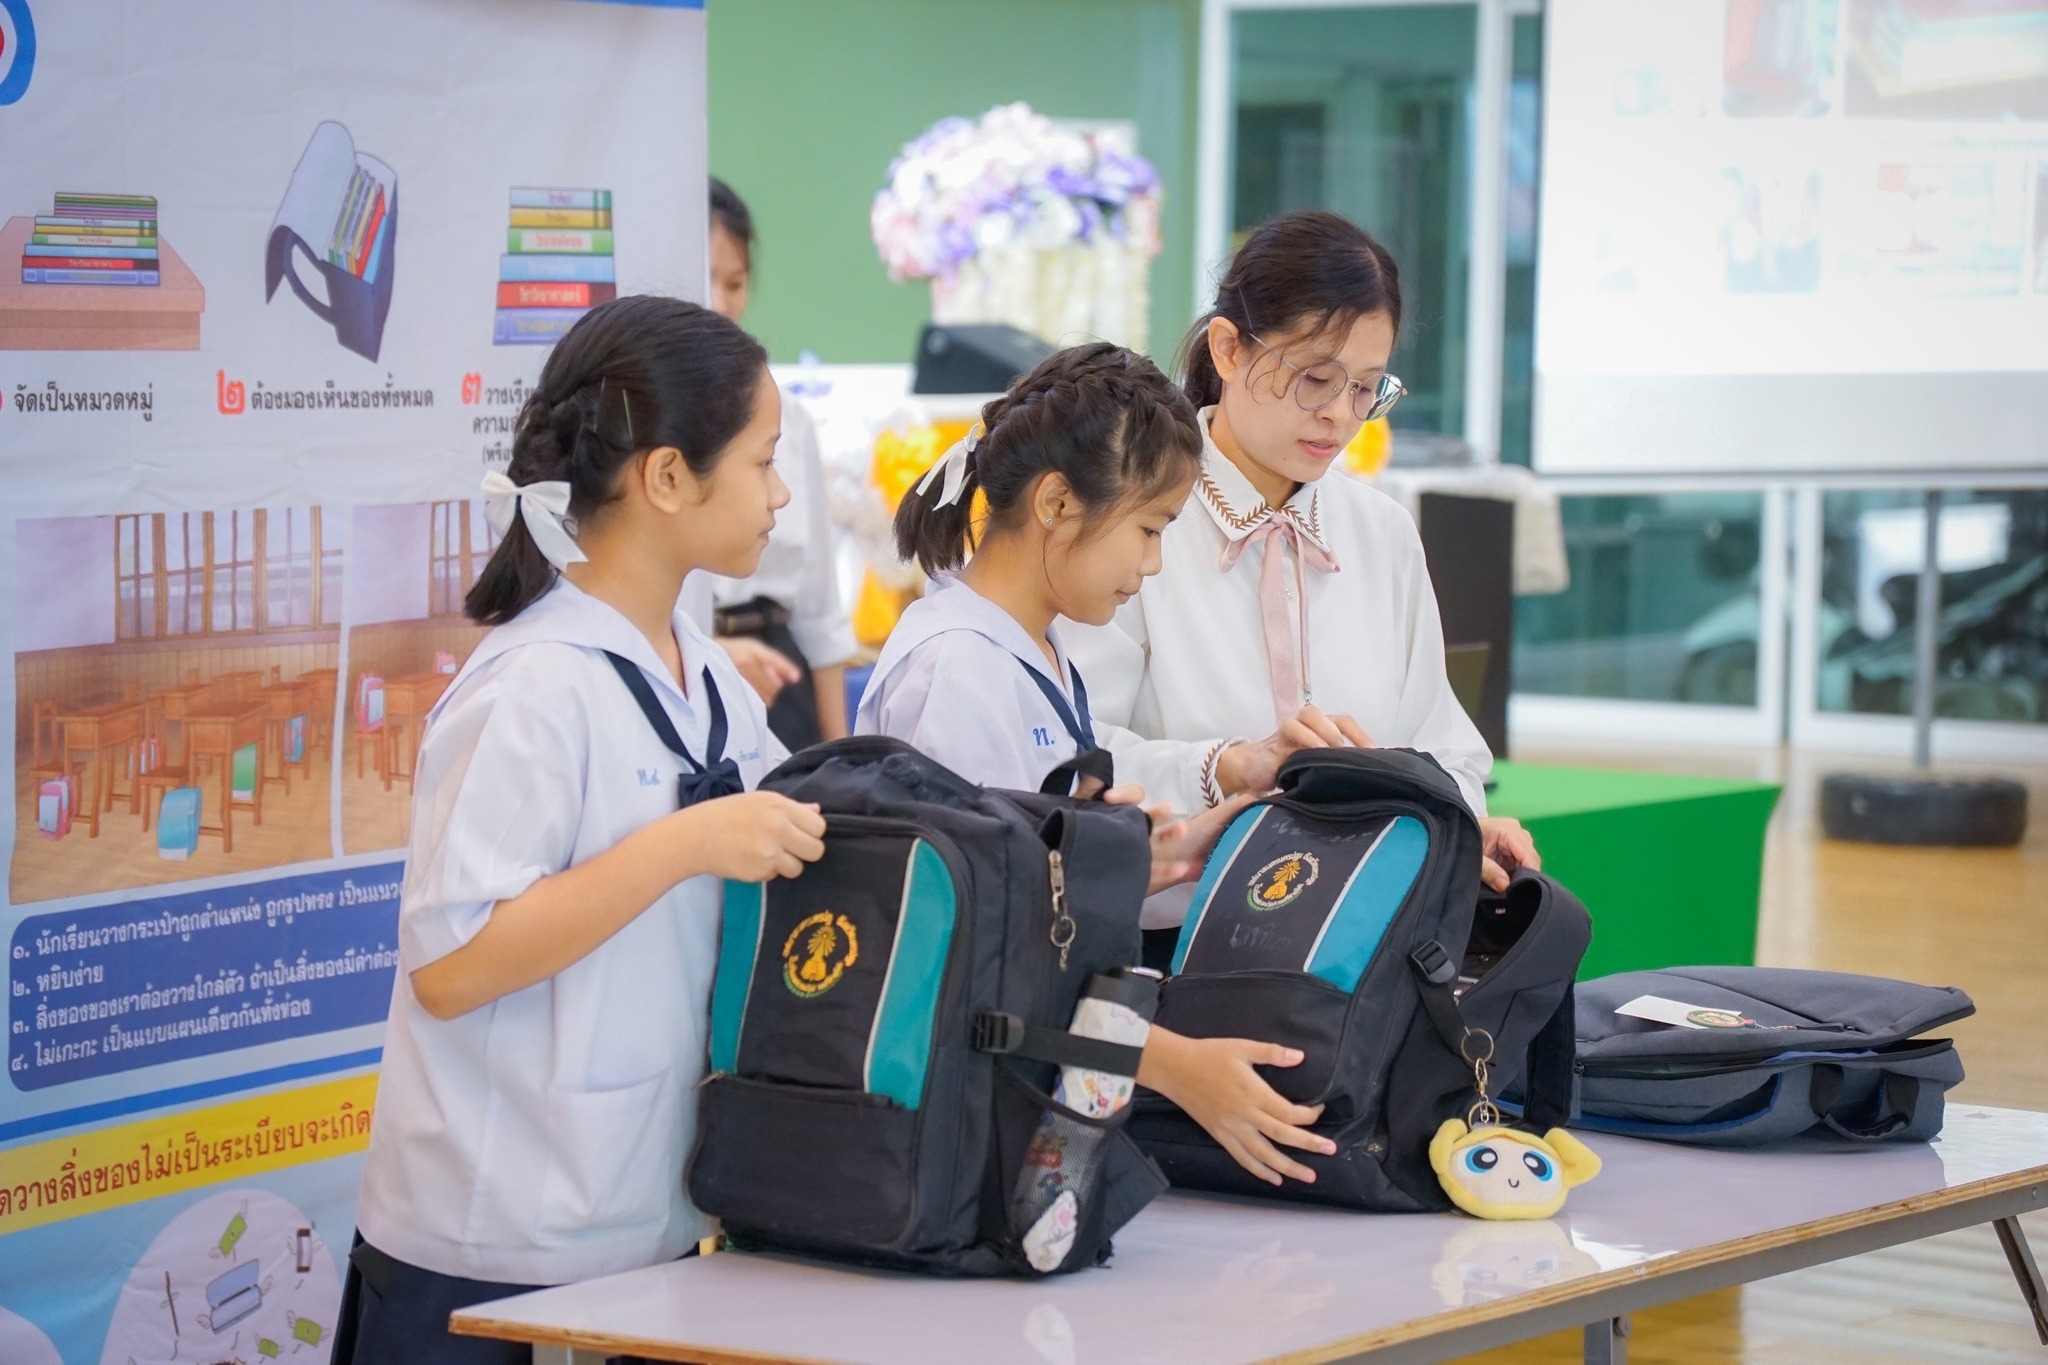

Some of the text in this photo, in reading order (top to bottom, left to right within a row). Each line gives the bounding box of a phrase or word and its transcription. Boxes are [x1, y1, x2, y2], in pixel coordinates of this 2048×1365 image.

[14, 381, 153, 422] จัดเป็นหมวดหมู่
[216, 369, 434, 415] ๒ ต้องมองเห็นของทั้งหมด
[36, 960, 104, 993] หยิบง่าย
[34, 1038, 98, 1067] ไม่เกะกะ
[0, 1101, 373, 1217] ดวางสิ่งของไม่เป็นระเบียบจะเกิด
